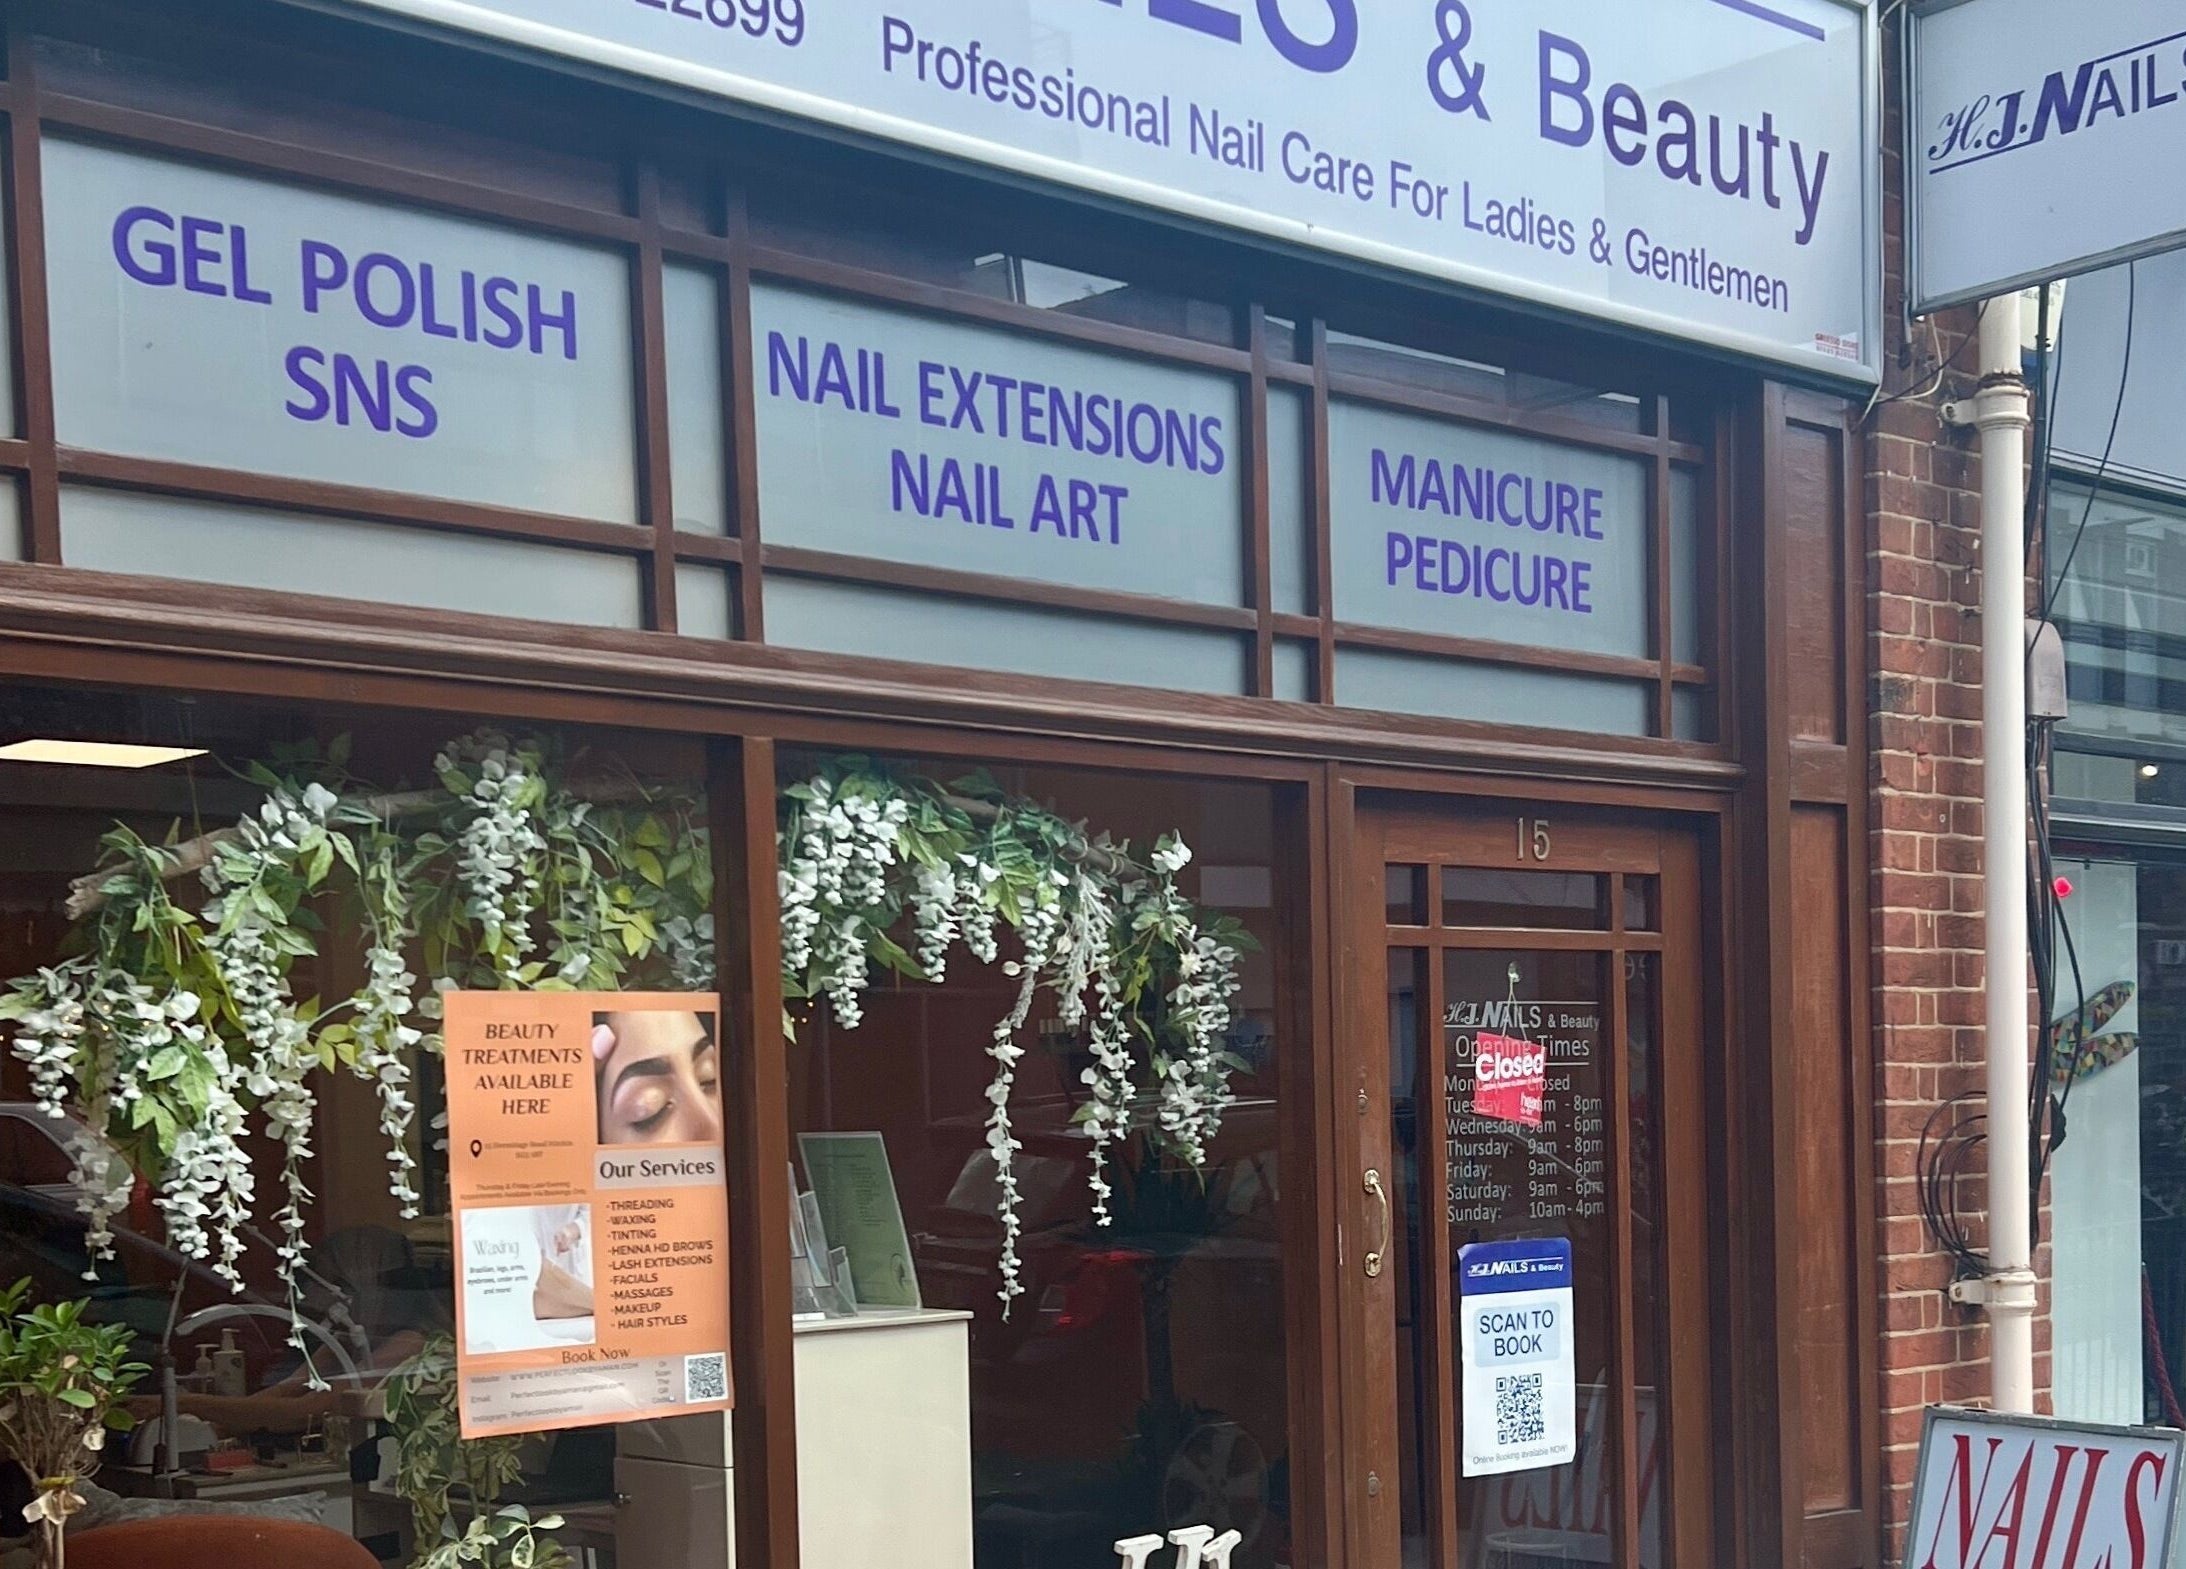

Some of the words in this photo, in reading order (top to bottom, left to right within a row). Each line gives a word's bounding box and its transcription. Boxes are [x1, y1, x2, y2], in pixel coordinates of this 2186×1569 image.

[635, 0, 805, 46] 899
[1928, 48, 2186, 161] H.J.NAIL
[1427, 0, 1491, 122] &
[1538, 29, 1829, 246] Beauty
[883, 16, 1170, 148] Professional
[1190, 103, 1265, 173] Nail
[1281, 131, 1374, 201] Care
[1390, 161, 1448, 221] For
[1464, 181, 1575, 256] Ladies
[1589, 218, 1613, 267] &
[1626, 228, 1788, 312] Gentlemen
[112, 206, 272, 305] GEL
[301, 239, 577, 361] POLISH
[285, 345, 438, 438] SNS
[767, 331, 900, 418] NAIL
[919, 360, 1224, 475] EXTENSIONS
[891, 449, 1013, 530] NAIL
[1030, 474, 1128, 545] ART
[1371, 448, 1604, 541] MANICURE
[1387, 532, 1592, 613] PEDICURE
[1516, 816, 1550, 861] 15
[486, 1024, 559, 1039] BEAUTY
[1548, 1014, 1556, 1027] &
[1561, 1014, 1599, 1031] Beauty
[463, 1048, 582, 1065] TREATMENTS
[1537, 1035, 1590, 1056] Times
[1476, 1047, 1544, 1081] Closed
[475, 1073, 573, 1089] AVAILABLE
[502, 1099, 550, 1115] HERE
[1573, 1095, 1602, 1115] 8pm
[1574, 1116, 1602, 1135] 6pm
[1528, 1138, 1557, 1154] 9am
[1574, 1137, 1603, 1155] 8pm
[600, 1161, 636, 1179] Our
[640, 1159, 715, 1177] Services
[1446, 1160, 1492, 1180] Friday:
[1529, 1159, 1557, 1176] 9am
[1575, 1157, 1603, 1177] 6pm
[1446, 1180, 1512, 1200] Saturday:
[1529, 1180, 1558, 1197] 9am
[1447, 1202, 1502, 1222] Sunday:
[1576, 1199, 1604, 1217] 4pm
[654, 1243, 670, 1252] HD
[673, 1240, 713, 1252] BROWS
[644, 1255, 713, 1268] EXTENSIONS
[618, 1318, 644, 1329] HAIR
[647, 1315, 688, 1327] STYLES
[1480, 1311, 1527, 1334] SCAN
[1532, 1309, 1553, 1329] TO
[562, 1349, 595, 1364] Book
[600, 1347, 631, 1360] Now
[1494, 1334, 1542, 1356] BOOK
[1921, 1434, 2167, 1569] NAILS
